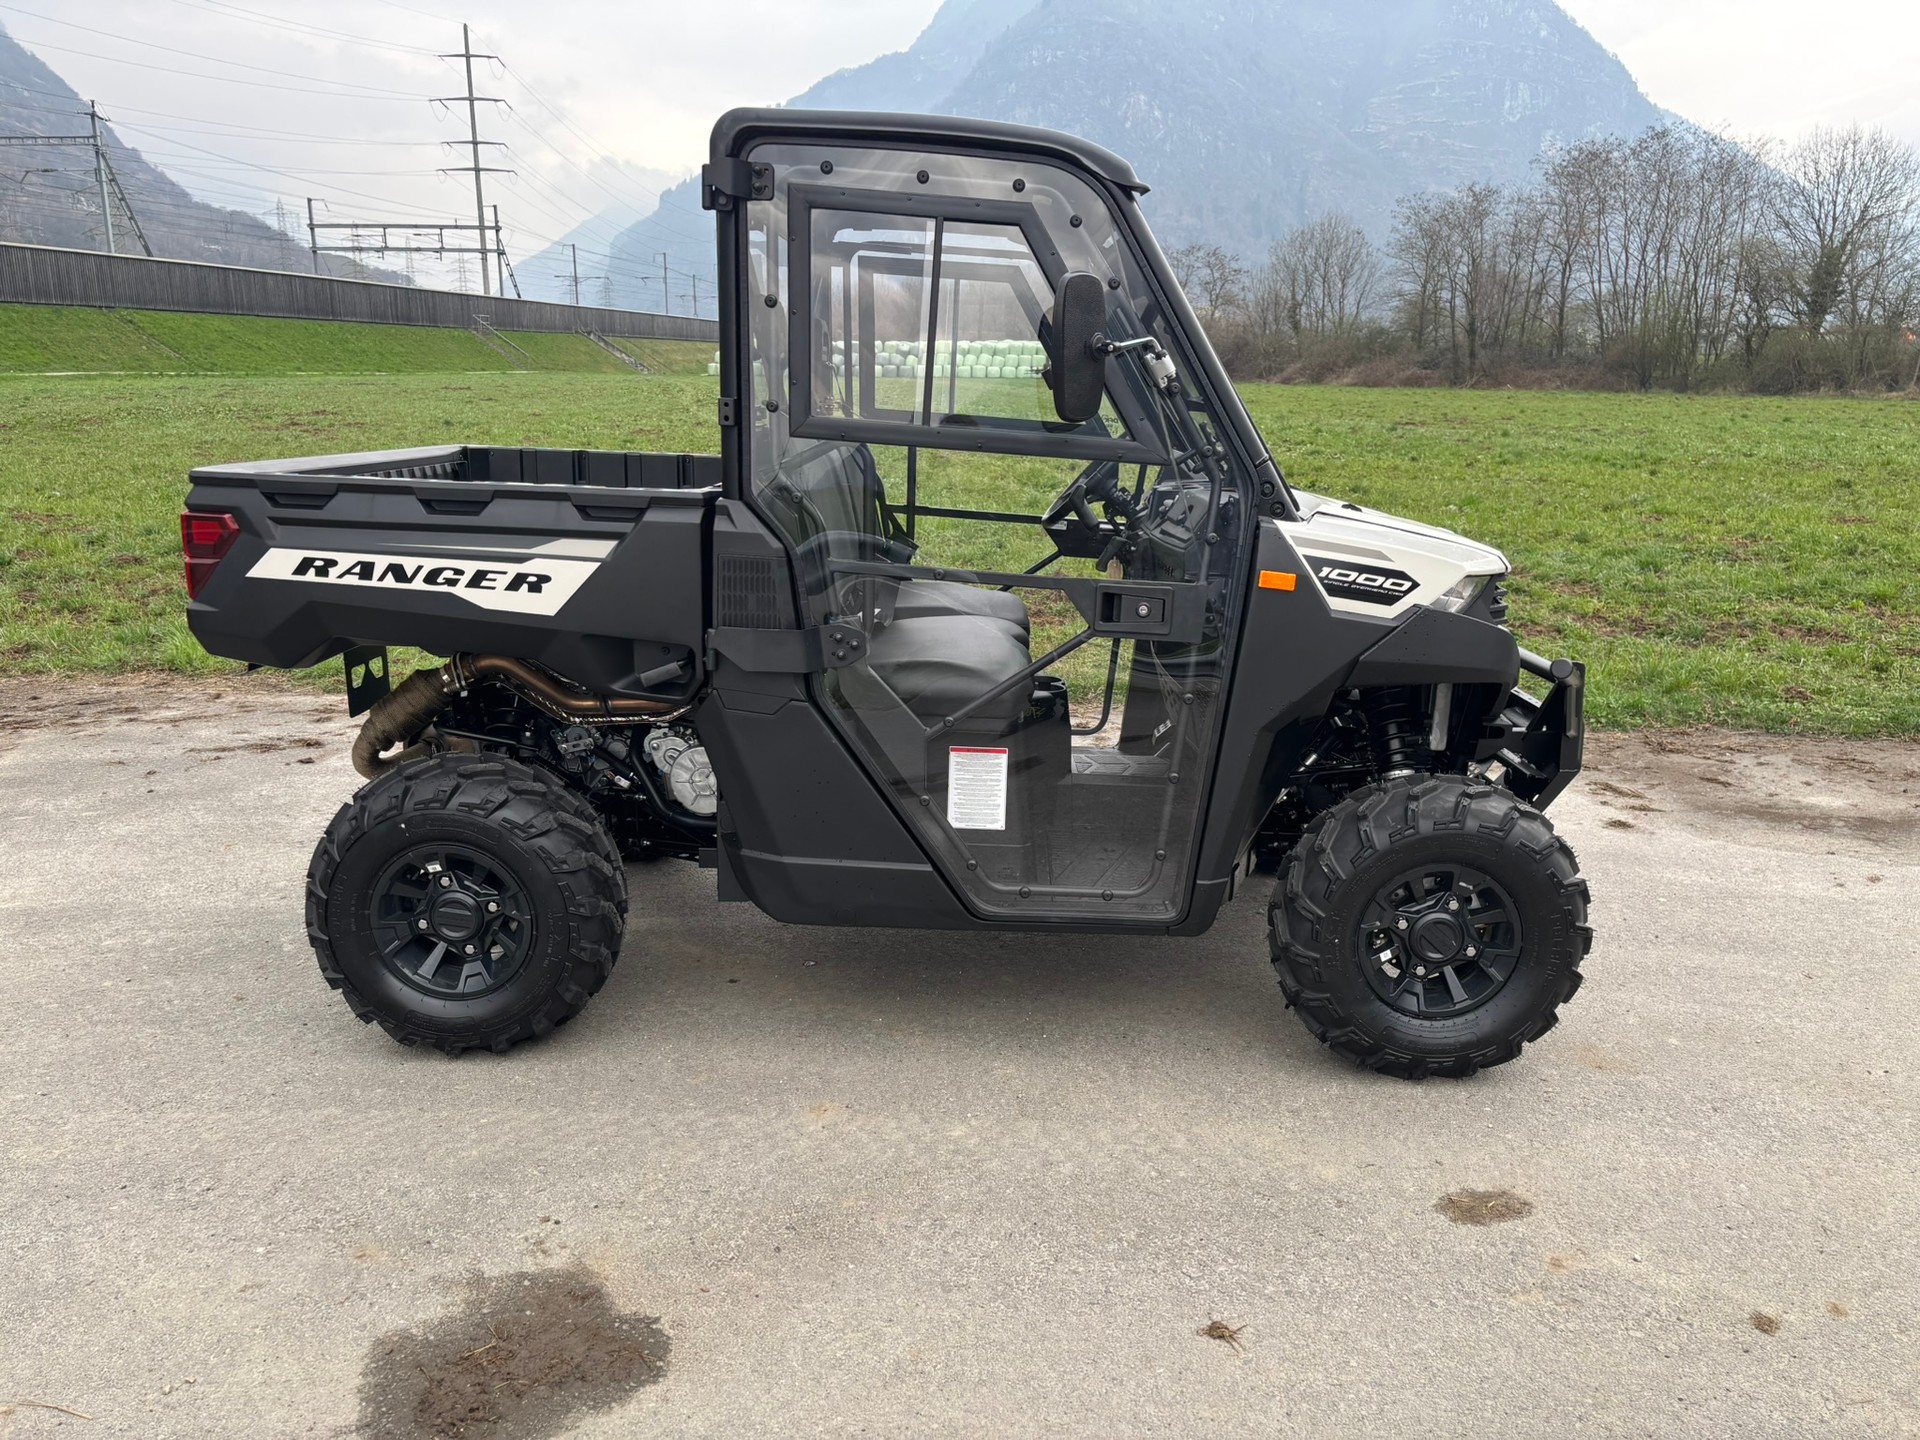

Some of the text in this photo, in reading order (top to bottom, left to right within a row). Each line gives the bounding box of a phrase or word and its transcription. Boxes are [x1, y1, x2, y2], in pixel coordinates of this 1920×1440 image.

[291, 556, 552, 594] RANGER
[1318, 567, 1412, 591] 1000
[1323, 579, 1350, 587] SINGLE
[1350, 584, 1388, 594] OVERHEAD
